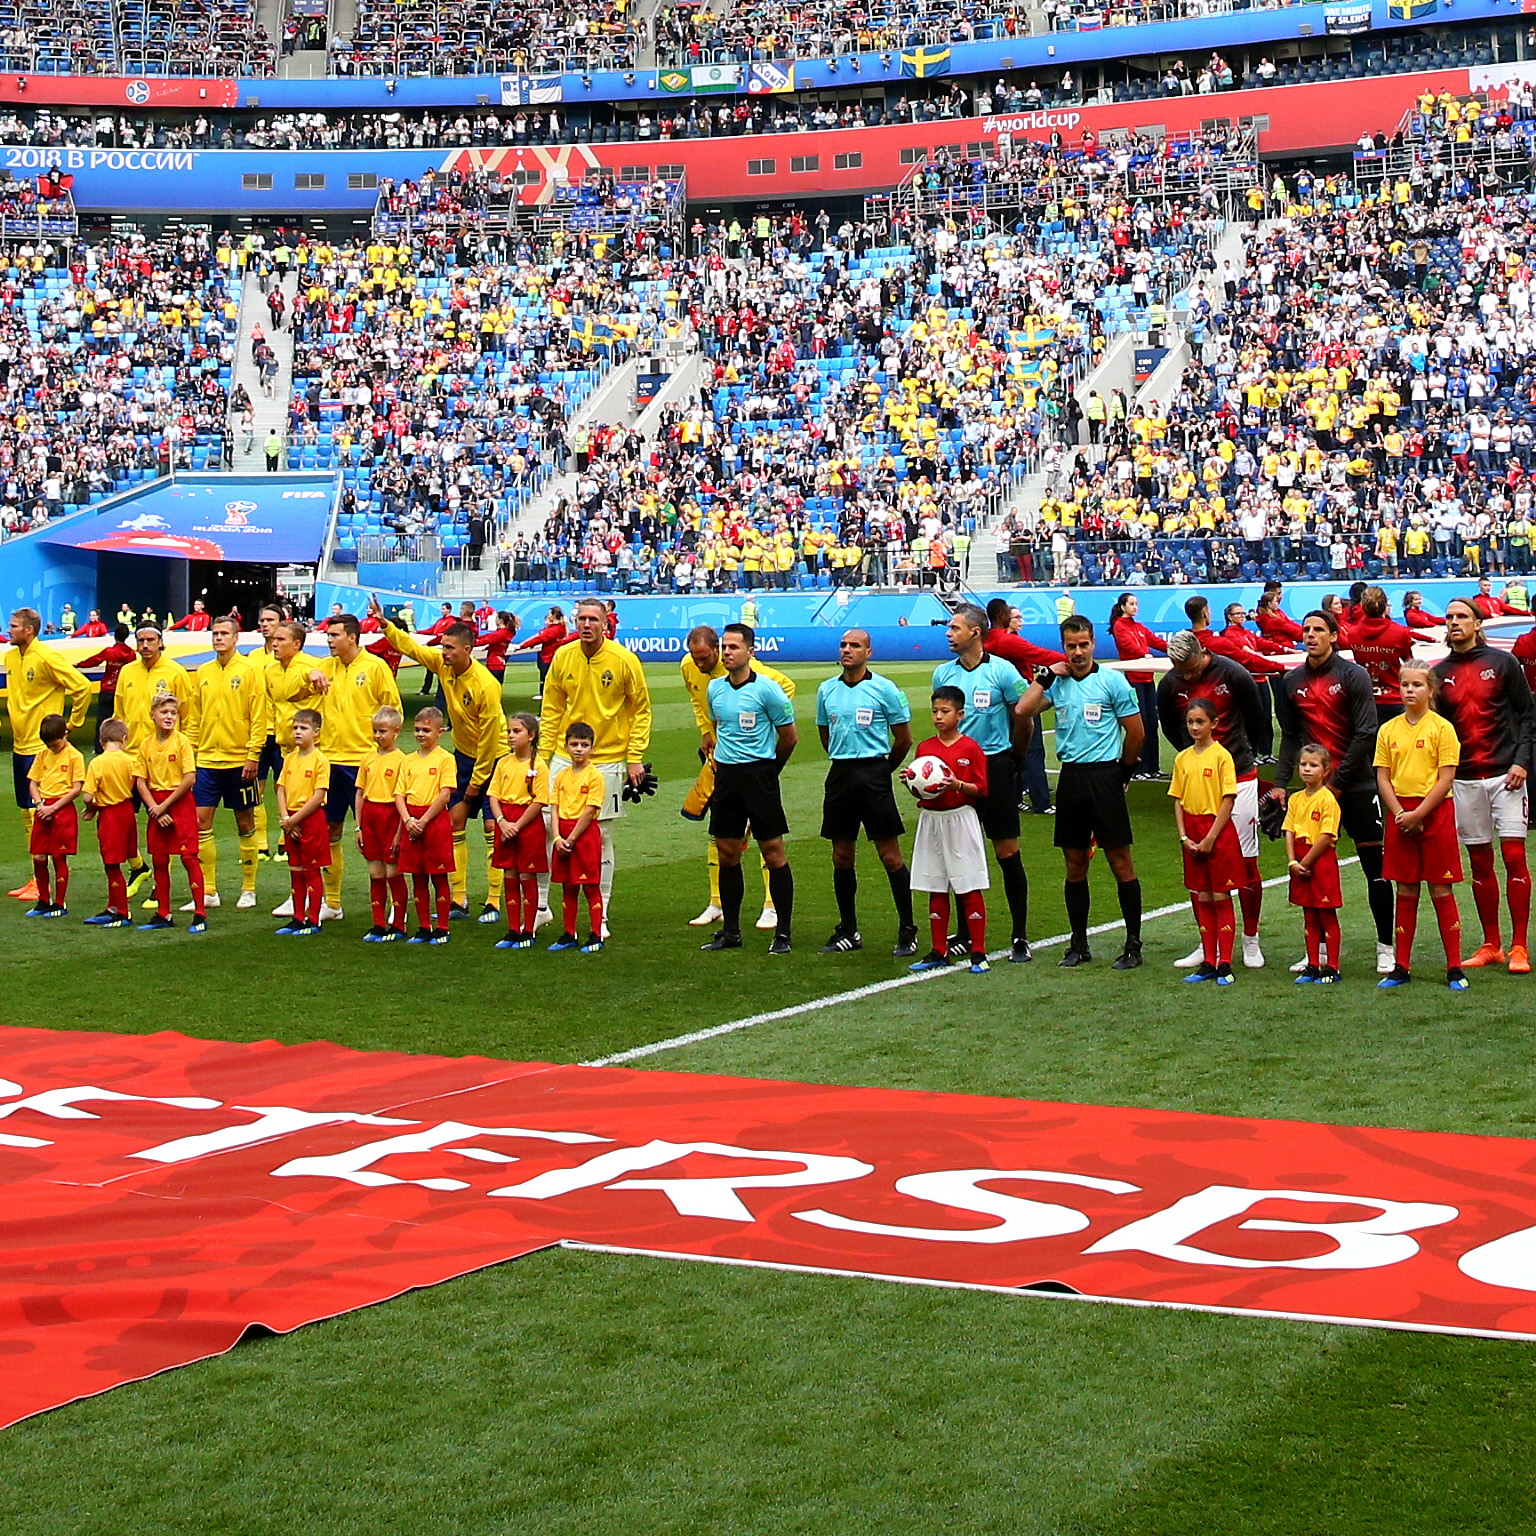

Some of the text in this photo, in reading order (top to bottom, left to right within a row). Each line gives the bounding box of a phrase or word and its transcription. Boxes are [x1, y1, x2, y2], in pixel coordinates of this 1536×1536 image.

[982, 111, 1081, 134] #worldcup
[5, 149, 62, 168] 2018
[68, 151, 85, 169] В
[282, 490, 327, 500] FIFA
[192, 525, 241, 533] RUSSIA
[624, 637, 681, 652] WORLD
[1350, 643, 1396, 655] Volunteer
[239, 786, 254, 805] 17
